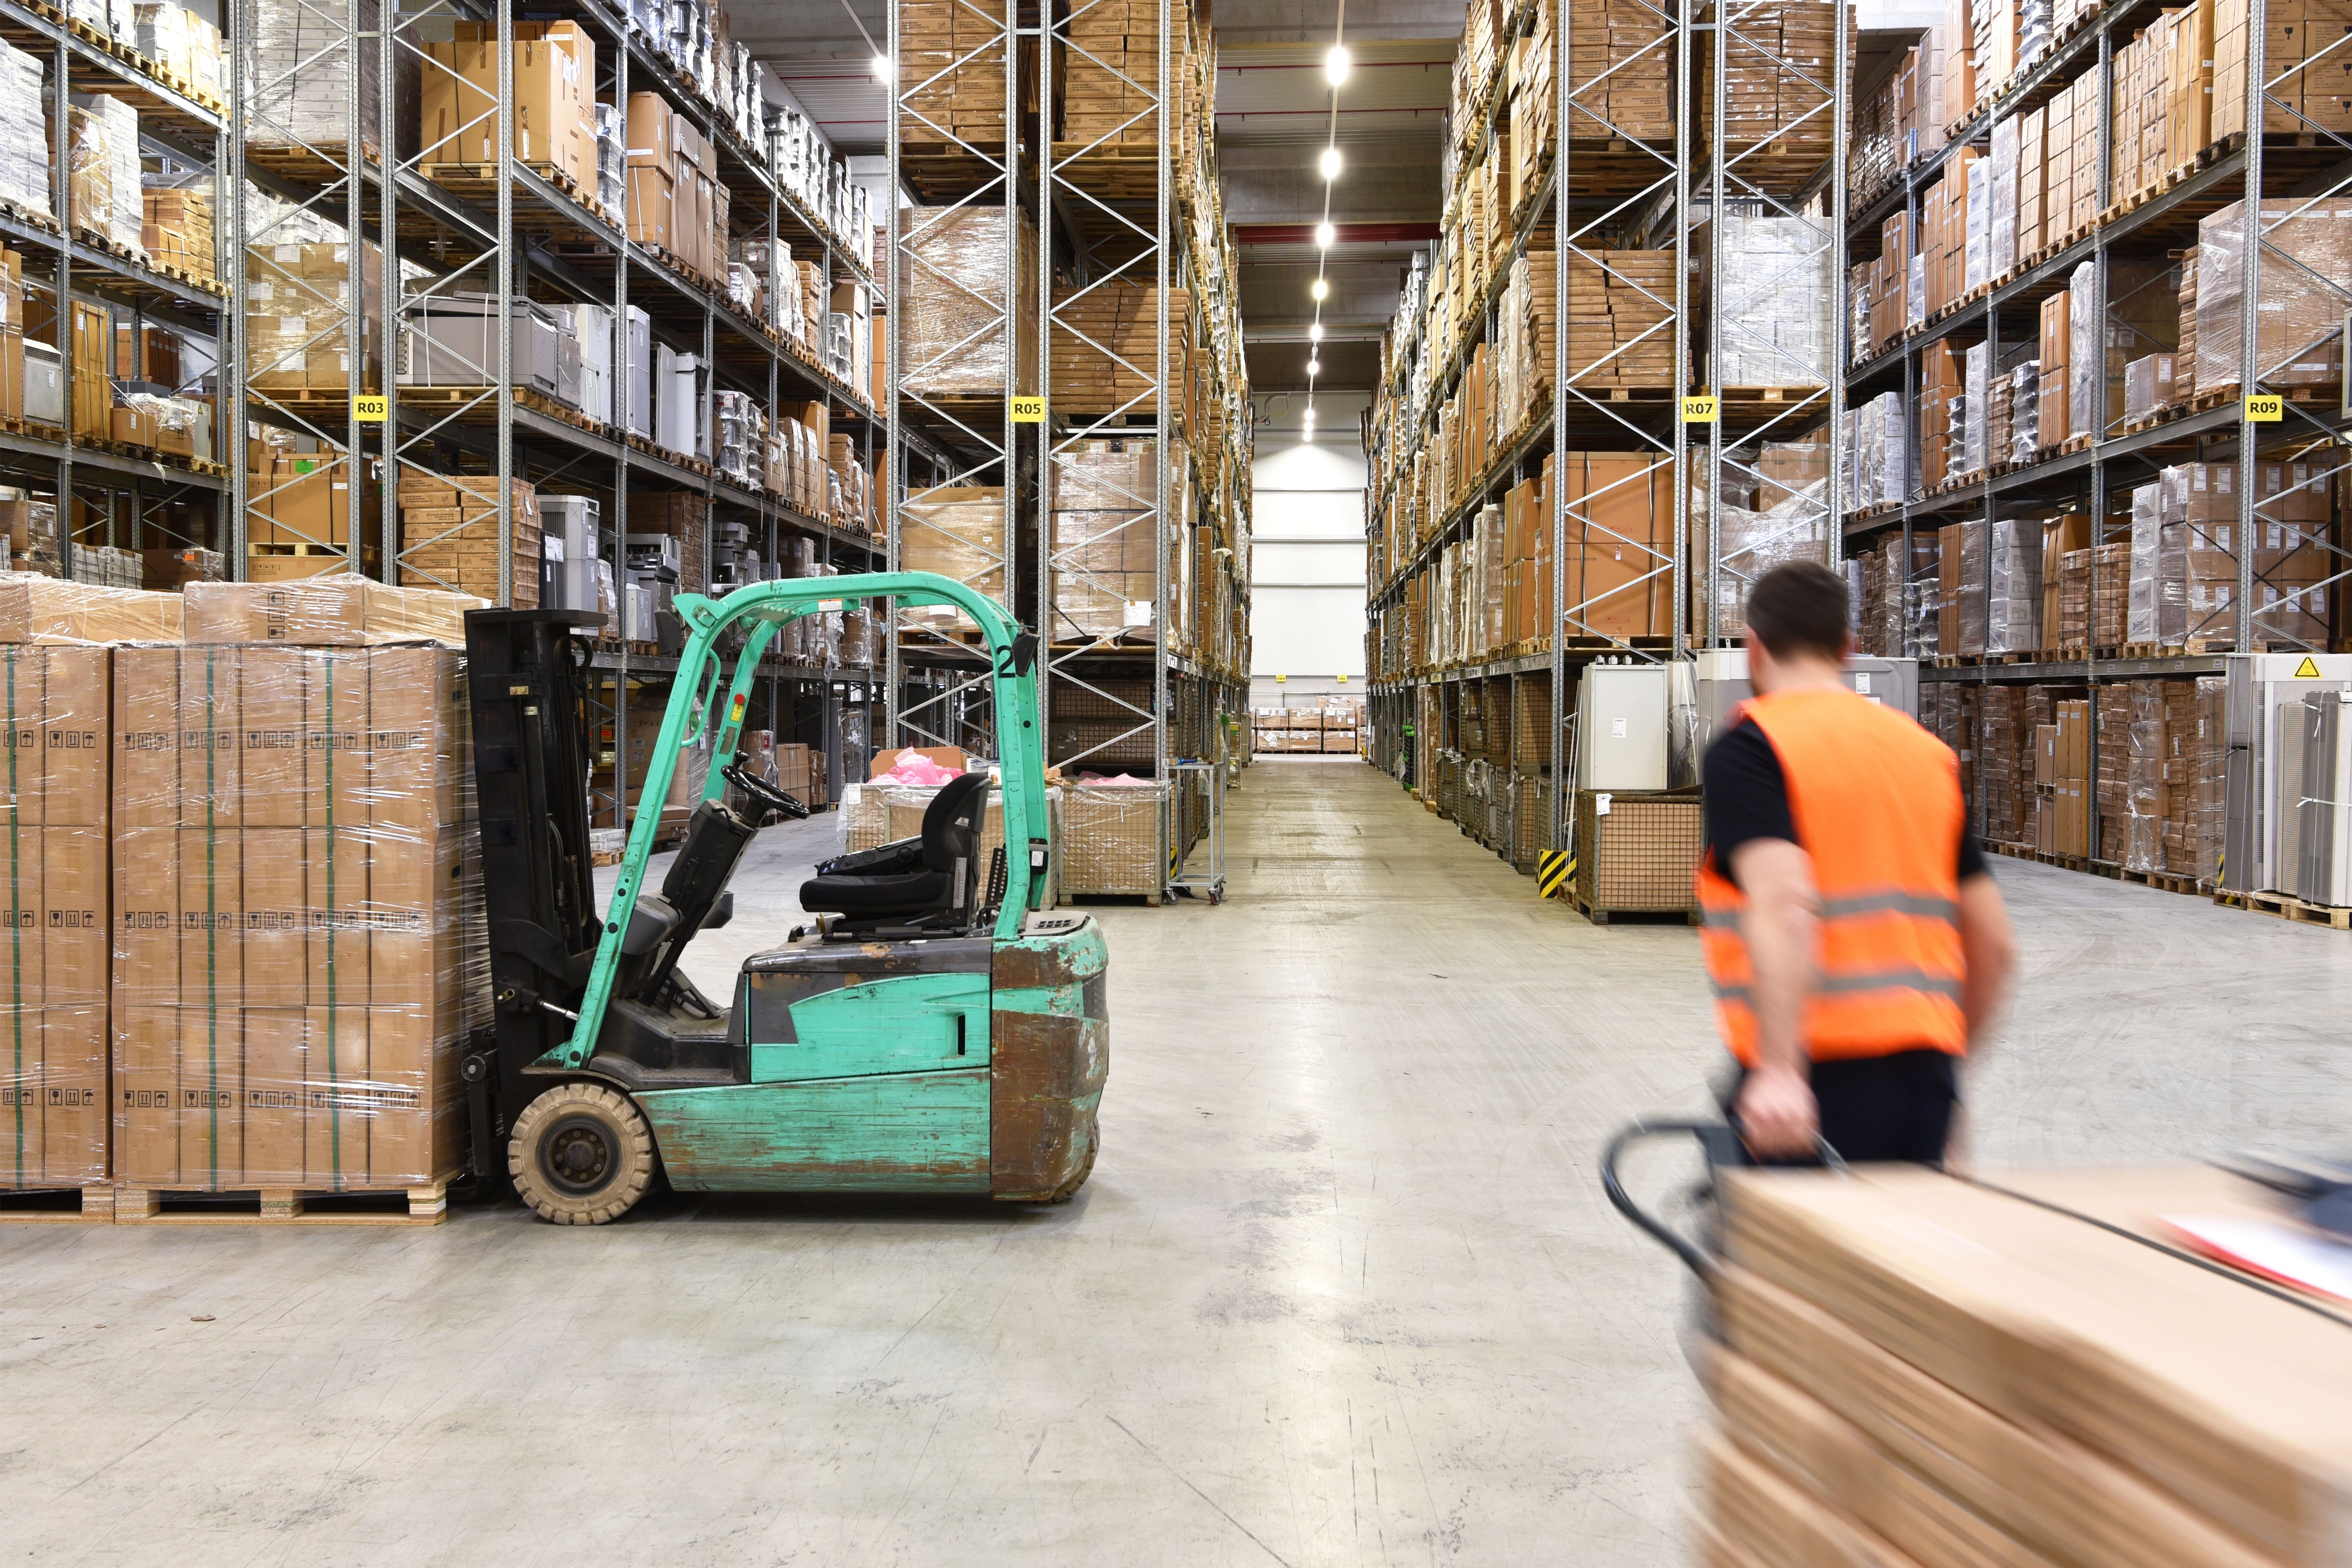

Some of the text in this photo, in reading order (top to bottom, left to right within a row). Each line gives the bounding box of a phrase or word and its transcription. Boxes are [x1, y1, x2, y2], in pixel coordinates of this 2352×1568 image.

[358, 402, 384, 413] R03
[1015, 404, 1041, 414] R05
[1685, 403, 1712, 414] R07
[2250, 402, 2277, 413] R09
[996, 645, 1016, 678] 2
